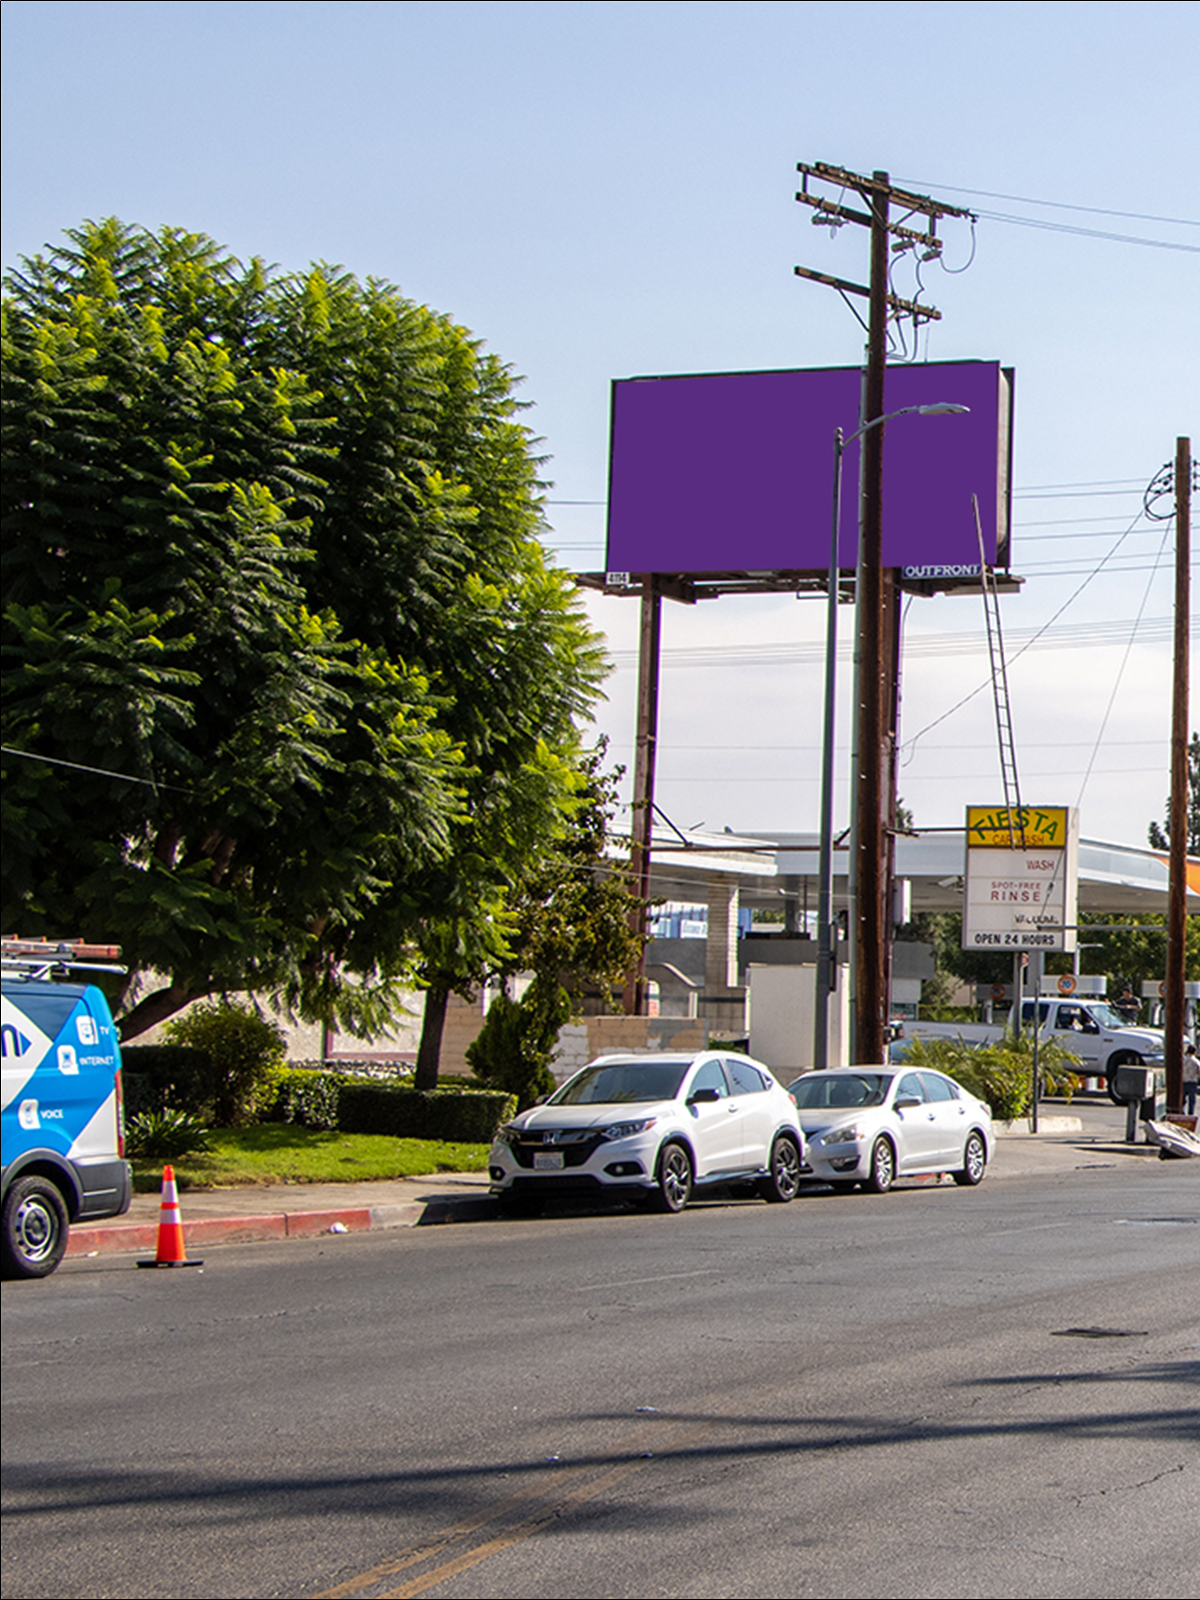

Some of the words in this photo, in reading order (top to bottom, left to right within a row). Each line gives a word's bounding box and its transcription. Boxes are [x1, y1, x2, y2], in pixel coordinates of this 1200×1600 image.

[905, 564, 980, 577] OUTFRONT
[973, 808, 1059, 841] FIESTA
[1026, 859, 1055, 871] WASH
[991, 881, 1041, 890] SPOT-FREE
[990, 890, 1041, 902] RINSE
[974, 933, 1001, 945] OPEN
[1004, 933, 1019, 945] 24
[1021, 934, 1055, 945] HOURS
[99, 1026, 110, 1035] TV
[79, 1055, 114, 1066] INTERNET
[40, 1109, 64, 1119] VOICE
